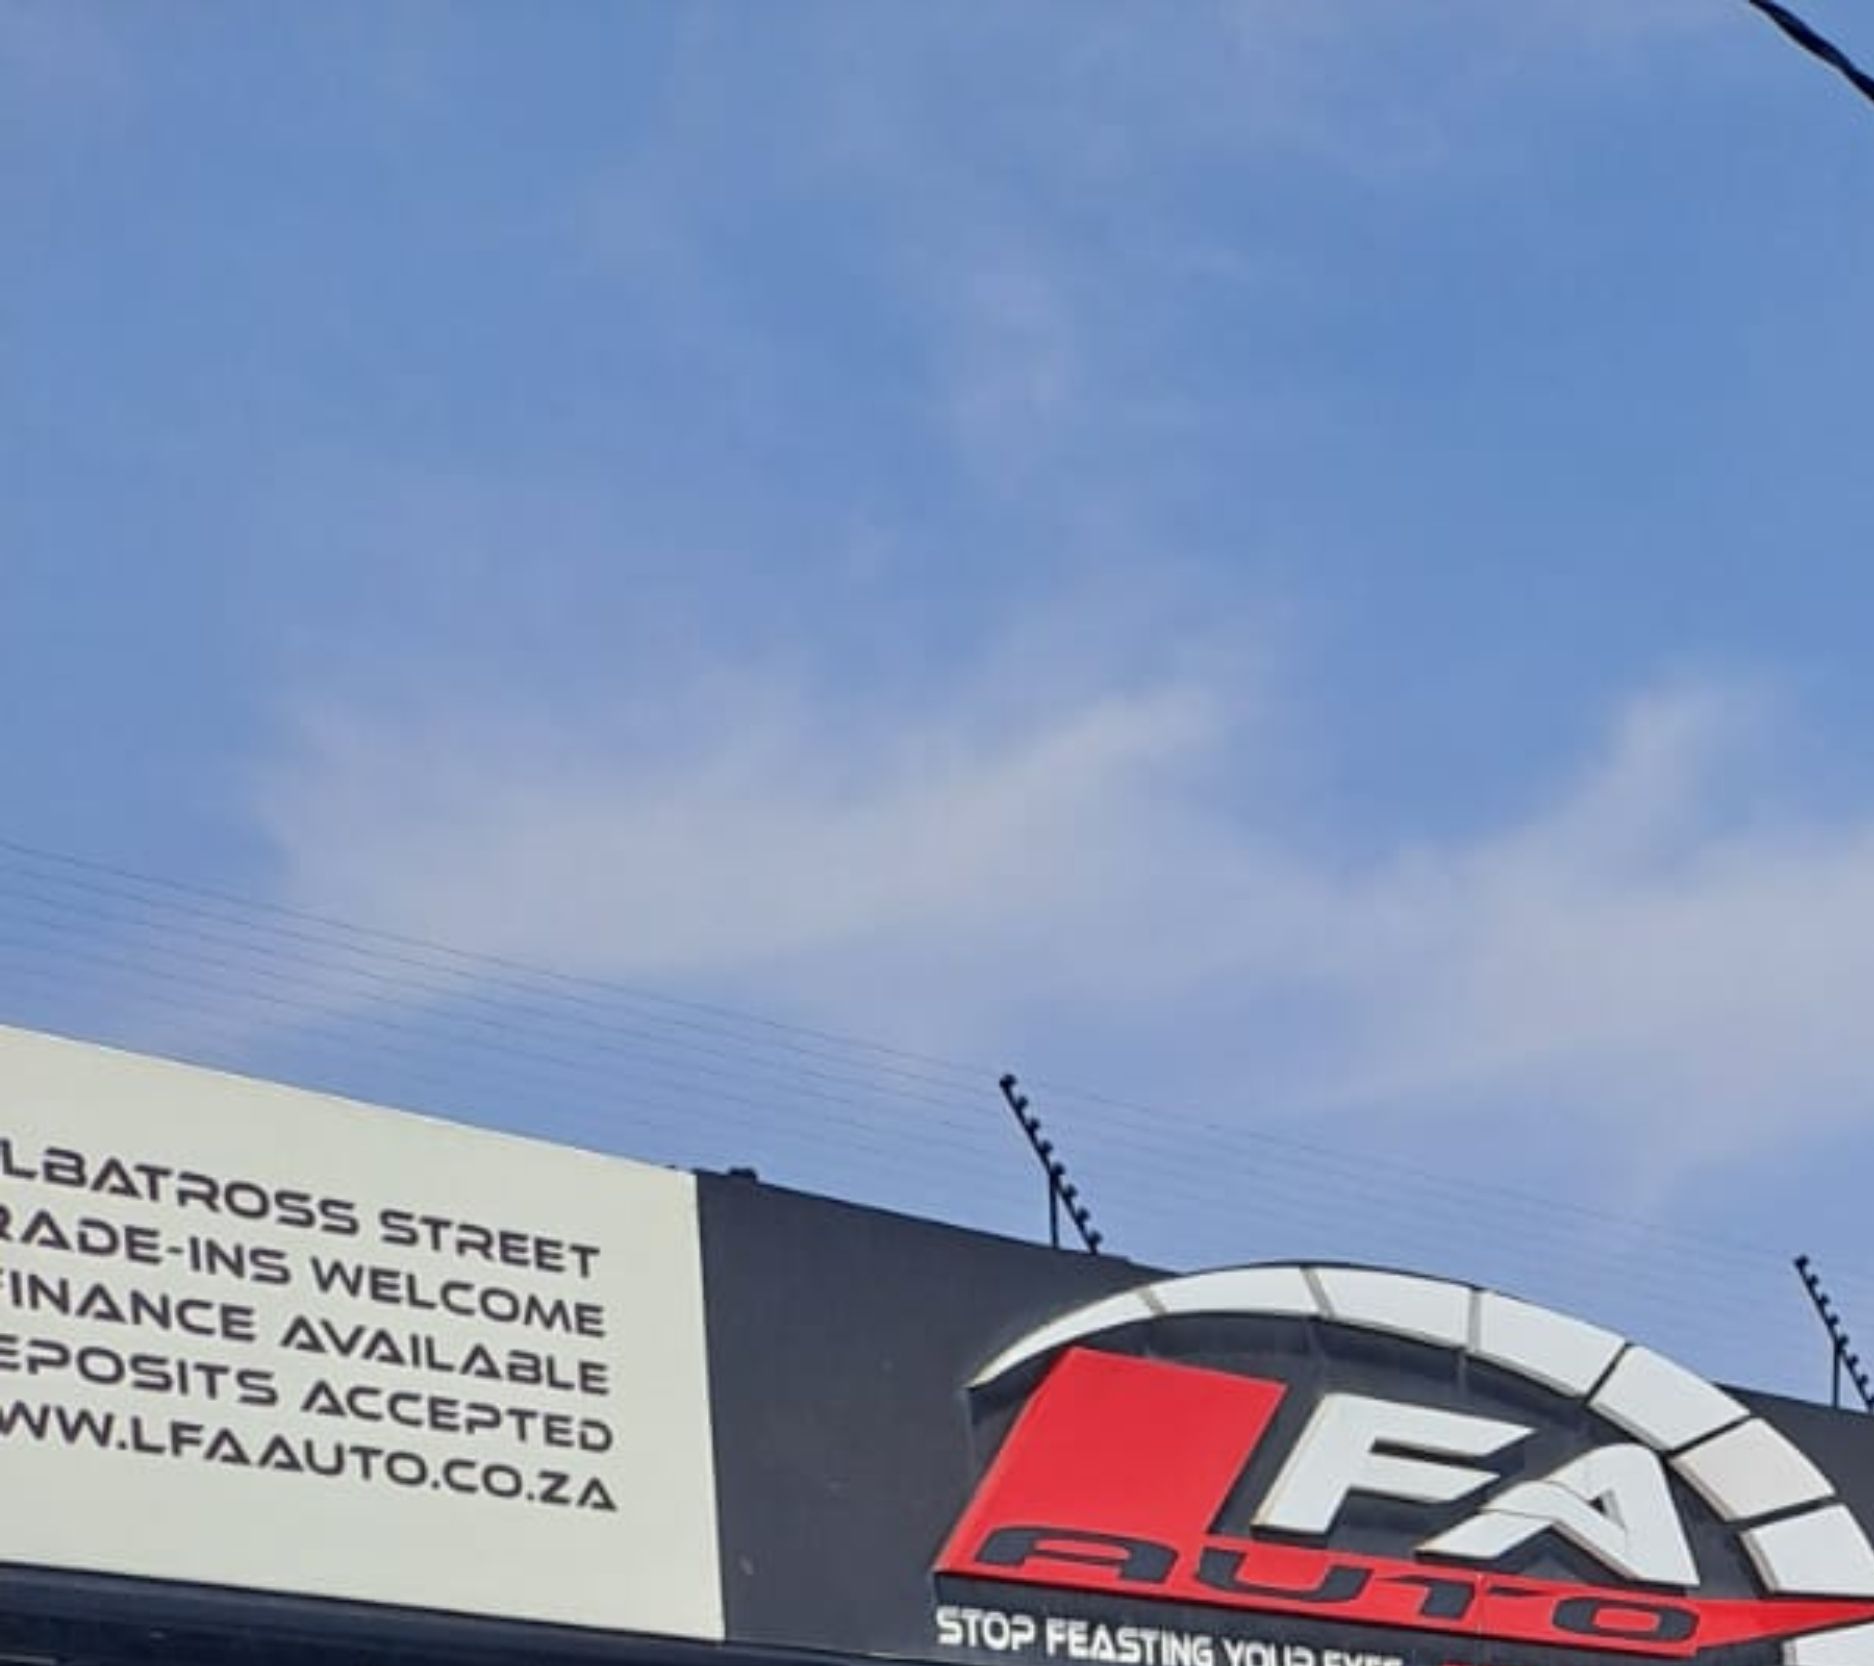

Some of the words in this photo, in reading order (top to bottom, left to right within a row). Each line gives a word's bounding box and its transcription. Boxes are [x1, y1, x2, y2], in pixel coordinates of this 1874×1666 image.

[379, 1208, 601, 1279] STREET
[0, 1269, 256, 1342] INANCE
[280, 1315, 610, 1396] AVAILABLE
[310, 1256, 605, 1338] WELCOME
[300, 1380, 614, 1453] ACCEPTED
[933, 1346, 1702, 1592] LFA
[970, 1526, 1702, 1643] AUTO
[935, 1606, 1037, 1655] STOP
